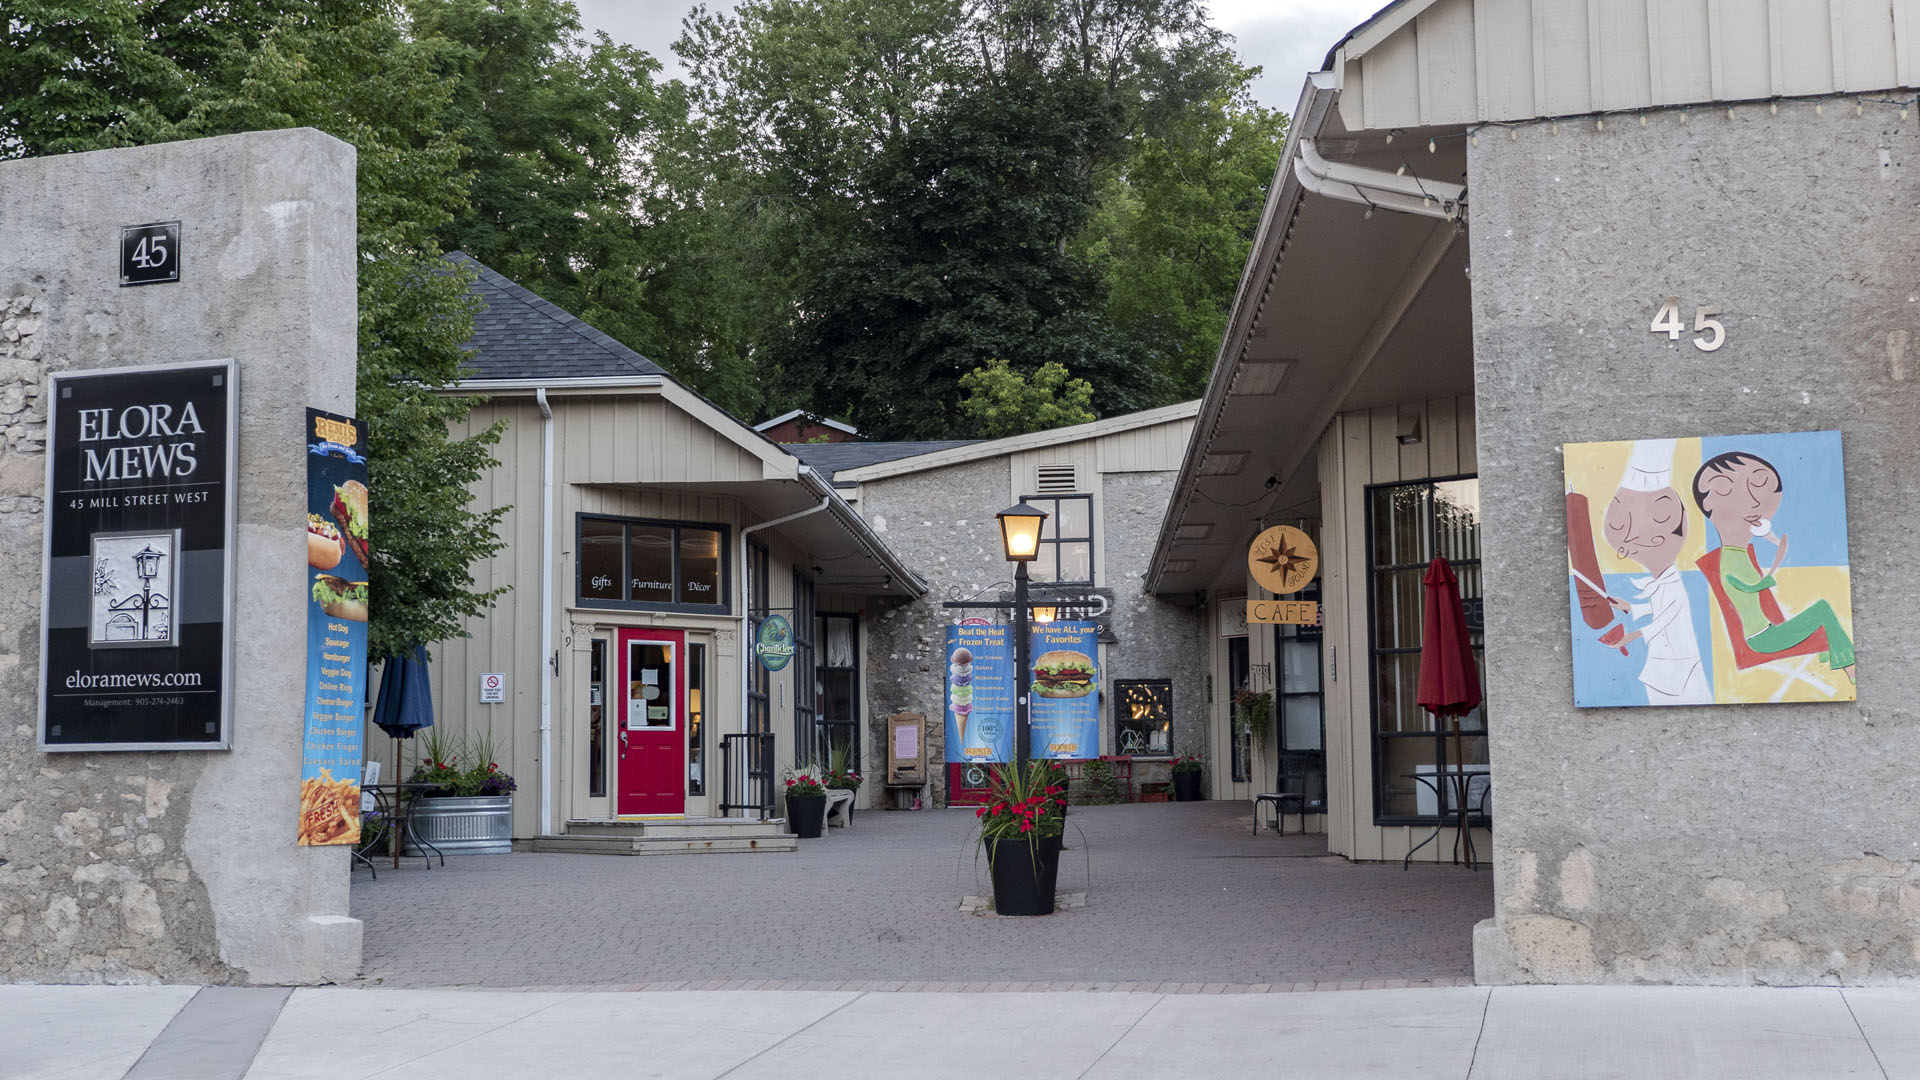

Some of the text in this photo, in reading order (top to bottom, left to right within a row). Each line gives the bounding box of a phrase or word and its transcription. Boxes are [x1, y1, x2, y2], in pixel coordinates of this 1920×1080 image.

[131, 235, 168, 268] 45
[1650, 296, 1725, 351] 45
[78, 401, 205, 441] ELORA
[83, 442, 197, 482] MEWS
[69, 492, 209, 510] 45 MILL STREET WEST
[1255, 535, 1275, 556] LOST
[1287, 561, 1312, 587] FOUND
[591, 575, 612, 590] Gifts
[632, 579, 672, 590] Furniture
[688, 581, 711, 592] Décor
[1254, 603, 1311, 621] CAFE
[328, 623, 349, 635] Hot Dog
[958, 627, 1005, 636] Beat the Heat
[1032, 625, 1044, 634] We
[1045, 625, 1061, 633] have
[1063, 625, 1078, 633] ALL
[1080, 626, 1096, 635] your
[325, 637, 350, 648] Sausage
[565, 636, 572, 647] 9
[959, 637, 982, 646] Frozen
[984, 637, 1004, 646] Treat
[1045, 634, 1082, 643] Favorites
[66, 670, 202, 688] eloramews.com
[305, 800, 339, 824] FRESH
